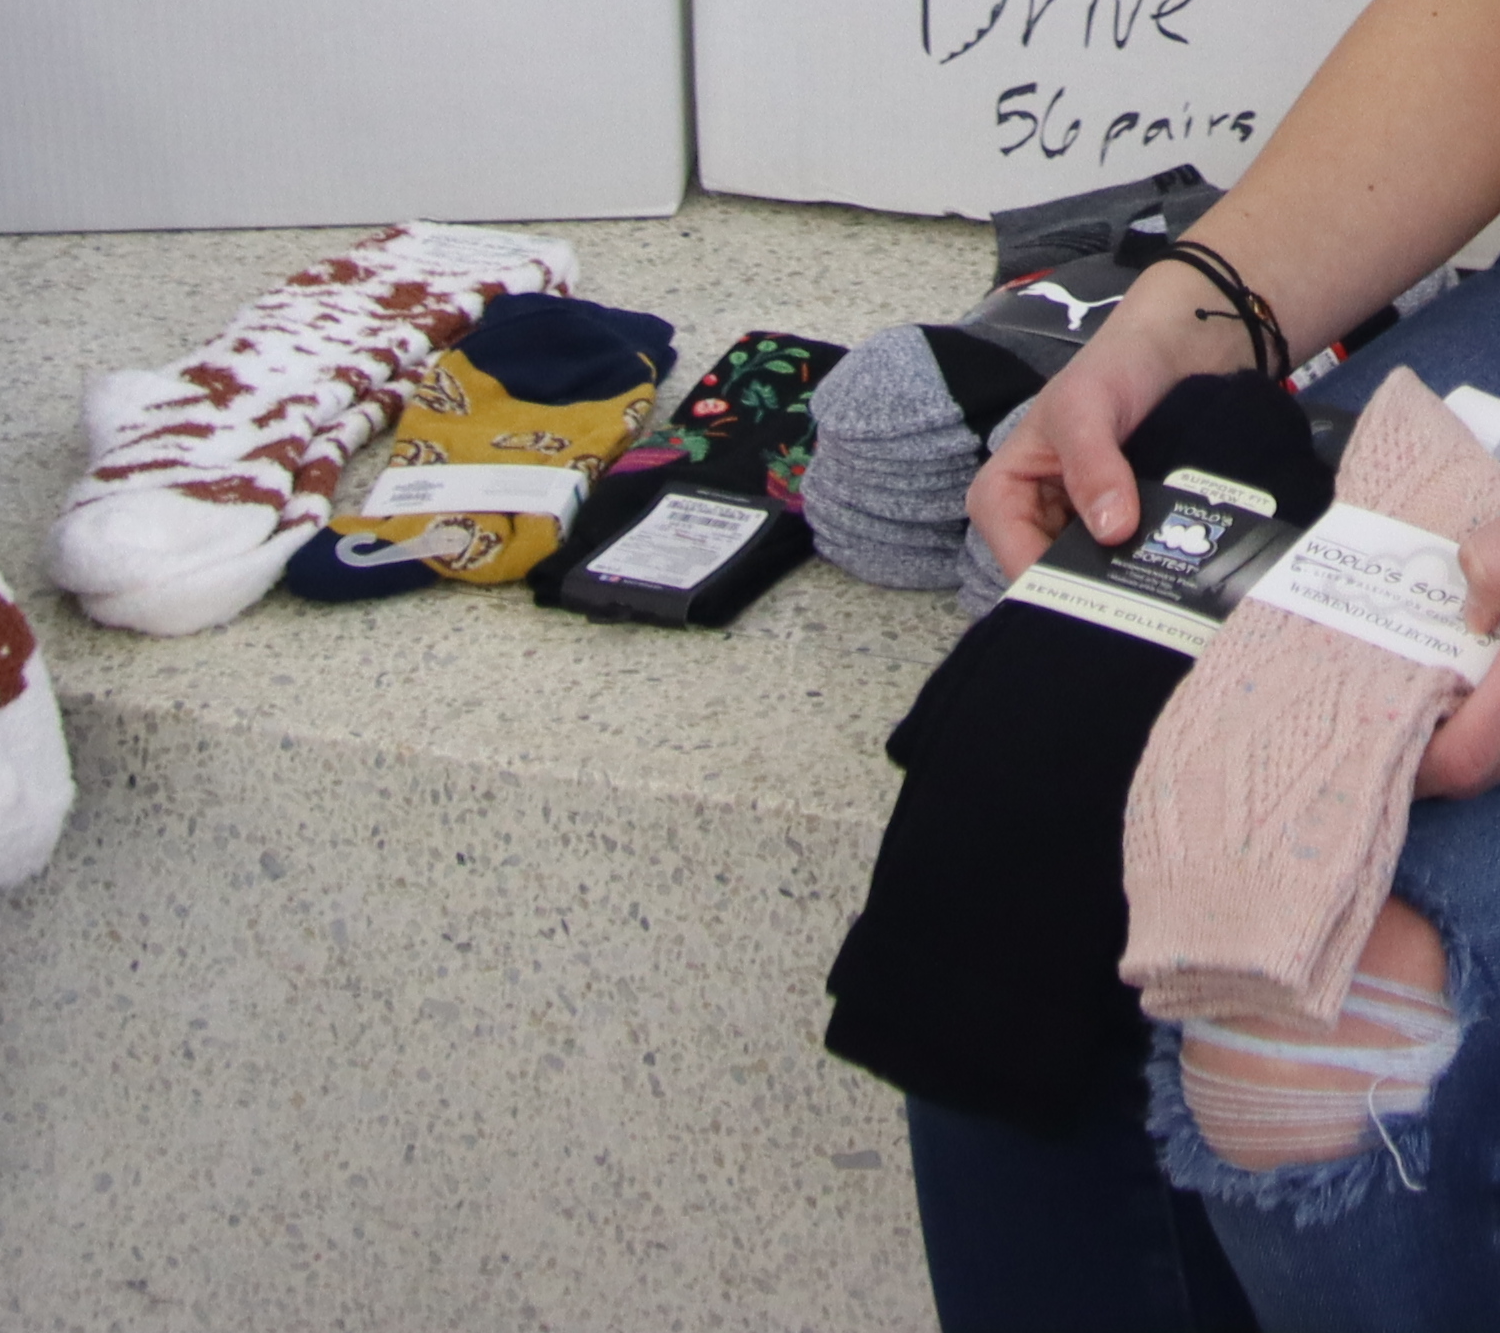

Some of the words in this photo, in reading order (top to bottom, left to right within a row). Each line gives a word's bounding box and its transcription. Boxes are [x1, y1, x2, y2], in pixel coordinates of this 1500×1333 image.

[994, 81, 1082, 160] 56
[1099, 99, 1258, 167] pairs
[1180, 471, 1246, 499] SUPPORT
[1199, 486, 1240, 505] CREW
[1172, 501, 1234, 528] WORLD'S
[1132, 549, 1199, 576] SOFTEST
[1304, 539, 1404, 584] WORLD'S
[1024, 582, 1110, 615] SENSITIVE
[1113, 606, 1209, 649] COLLECTIO
[1290, 580, 1365, 619] WEEKEND
[1365, 610, 1464, 659] COLLECTION
